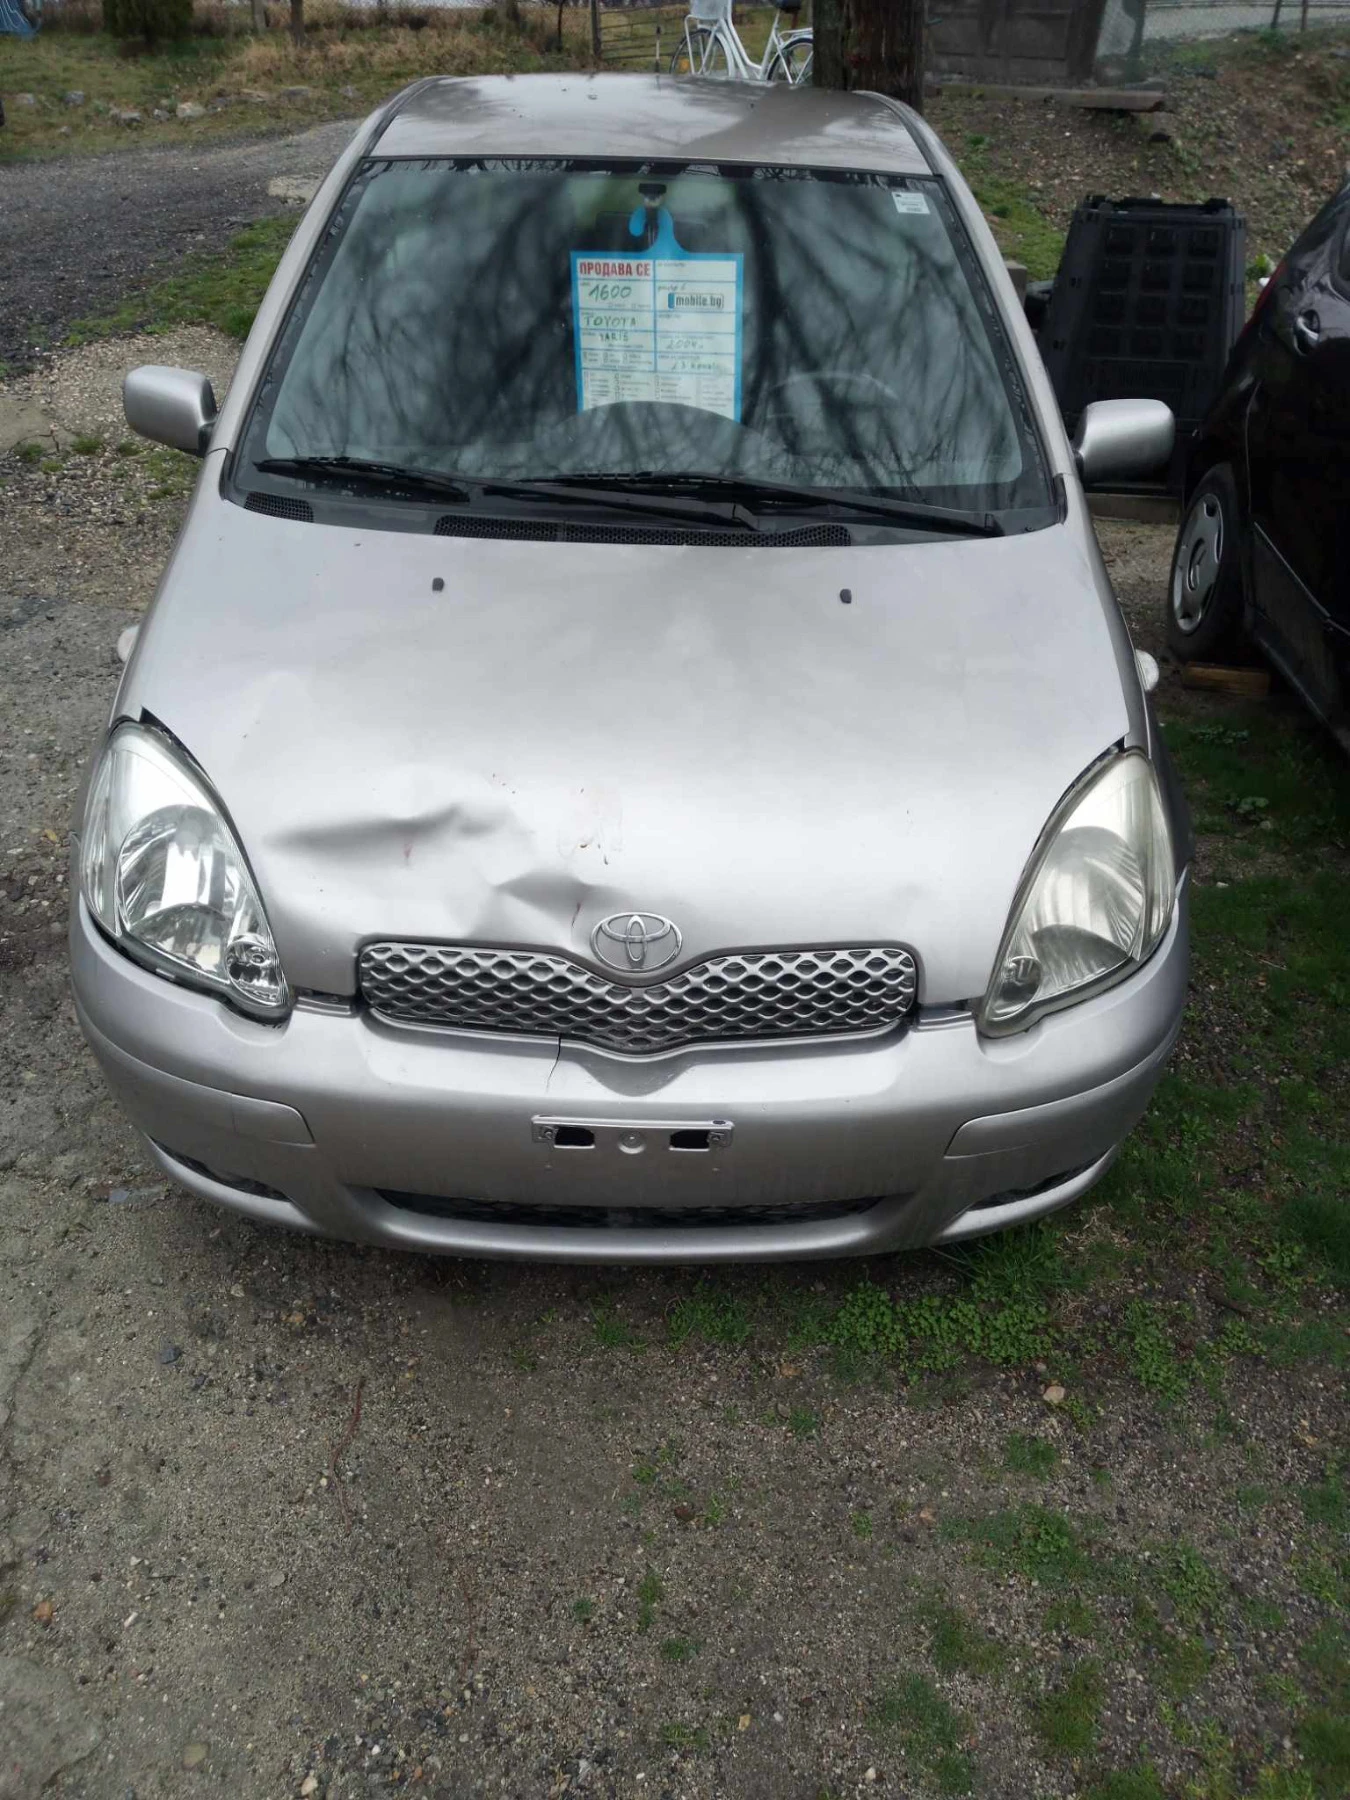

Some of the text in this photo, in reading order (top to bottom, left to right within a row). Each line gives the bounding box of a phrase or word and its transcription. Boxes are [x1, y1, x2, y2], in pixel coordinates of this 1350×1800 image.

[579, 262, 651, 277] ПРОДАВА СЕ
[588, 283, 632, 302] 1600
[676, 295, 722, 309] mobile.bg
[584, 315, 636, 328] TOYOTA
[600, 331, 628, 342] YARIS
